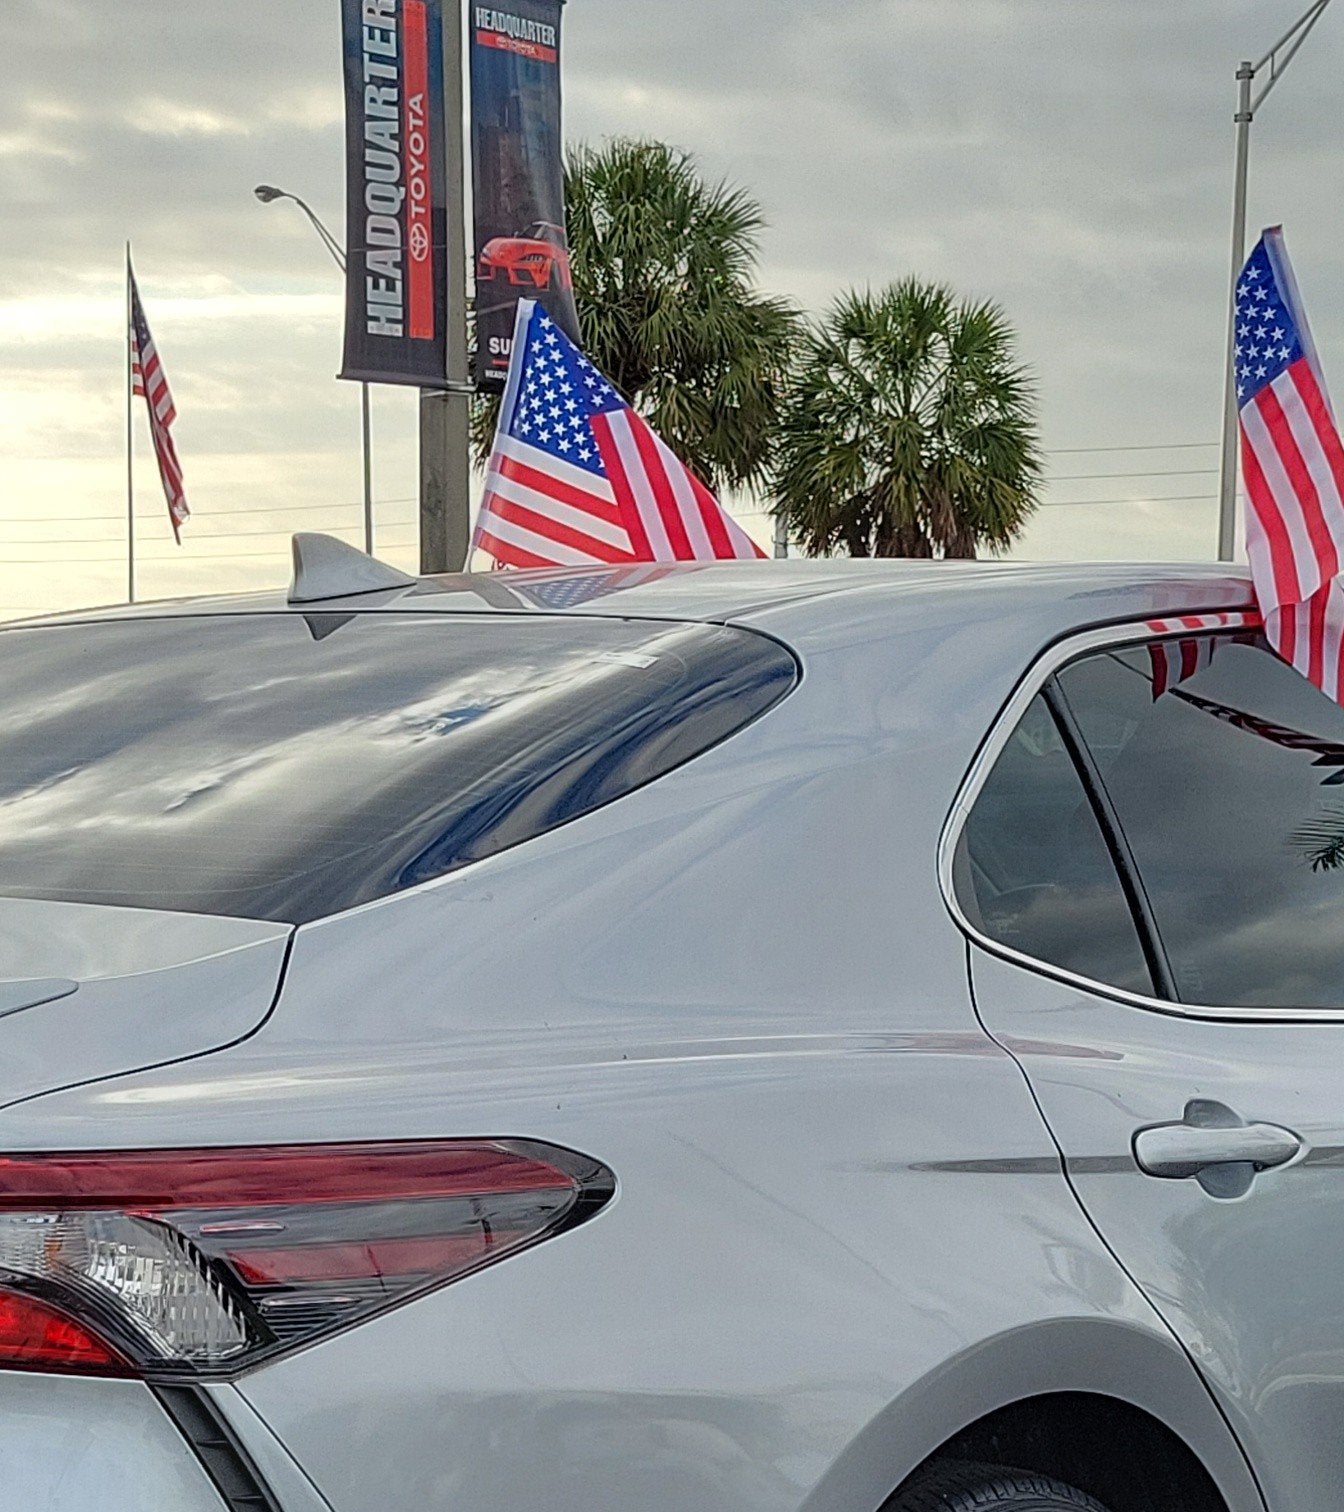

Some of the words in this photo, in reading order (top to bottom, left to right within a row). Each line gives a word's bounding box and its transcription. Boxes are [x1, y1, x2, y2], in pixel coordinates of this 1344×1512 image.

[475, 6, 556, 47] HEADQUARTER
[362, 0, 406, 338] HEADQUARTER
[409, 92, 426, 219] TOYOTA
